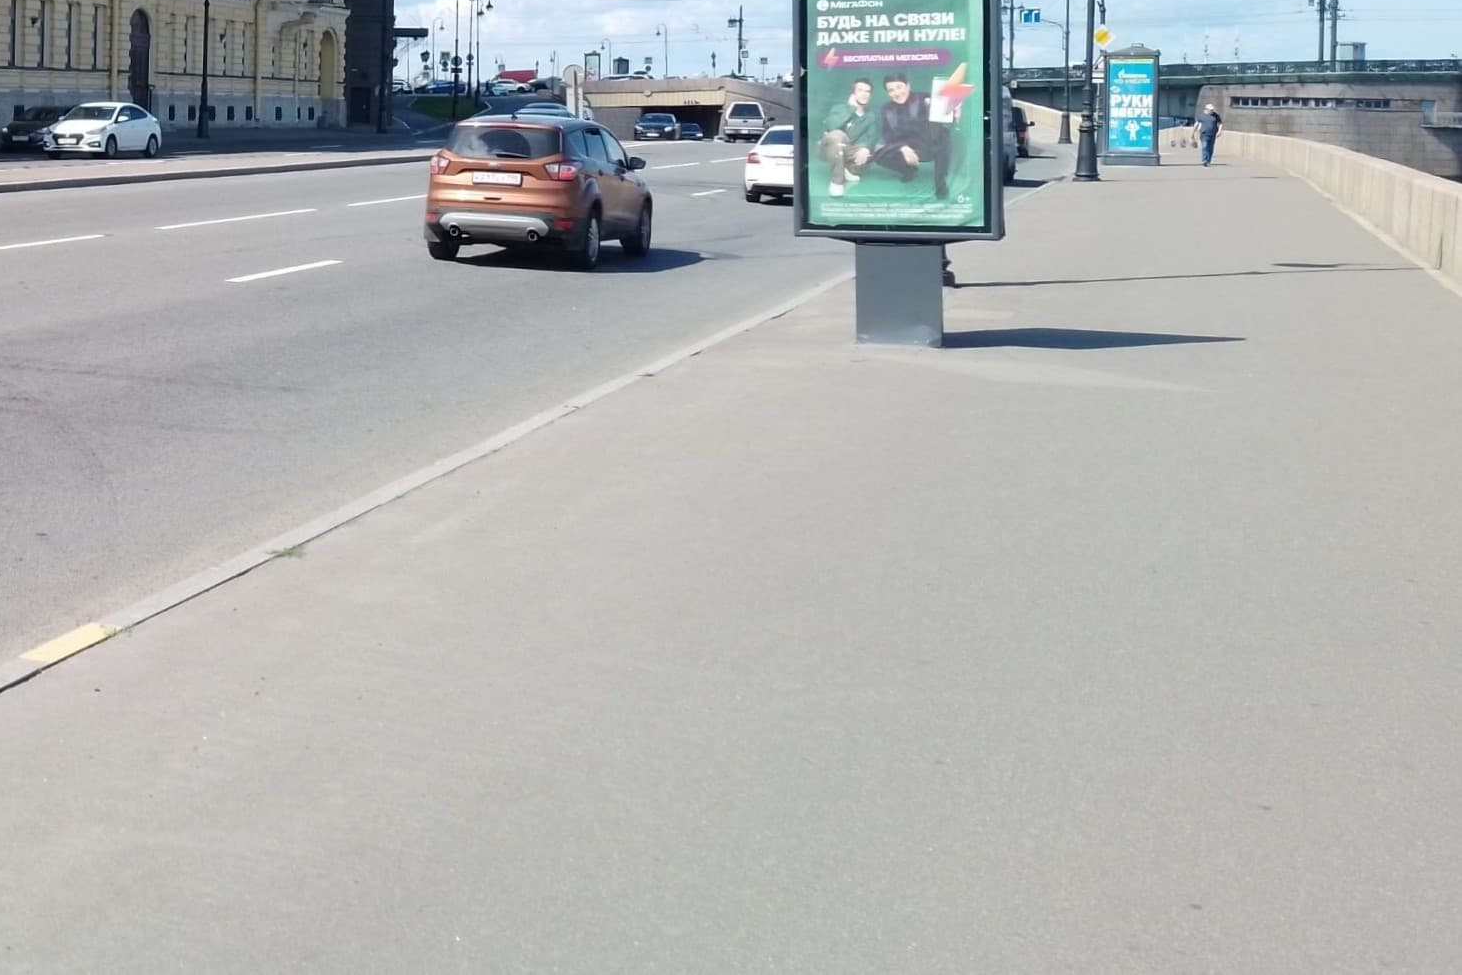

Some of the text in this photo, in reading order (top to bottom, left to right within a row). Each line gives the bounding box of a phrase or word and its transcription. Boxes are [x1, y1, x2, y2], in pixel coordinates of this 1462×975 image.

[817, 12, 954, 29] БУДЬ НА СВЯЗИ
[816, 28, 966, 46] ДАЖЕ ПРИ НУЛЕ!
[843, 54, 894, 62] БЕСПЛАТНАЯ
[1110, 94, 1153, 106] РУКИ
